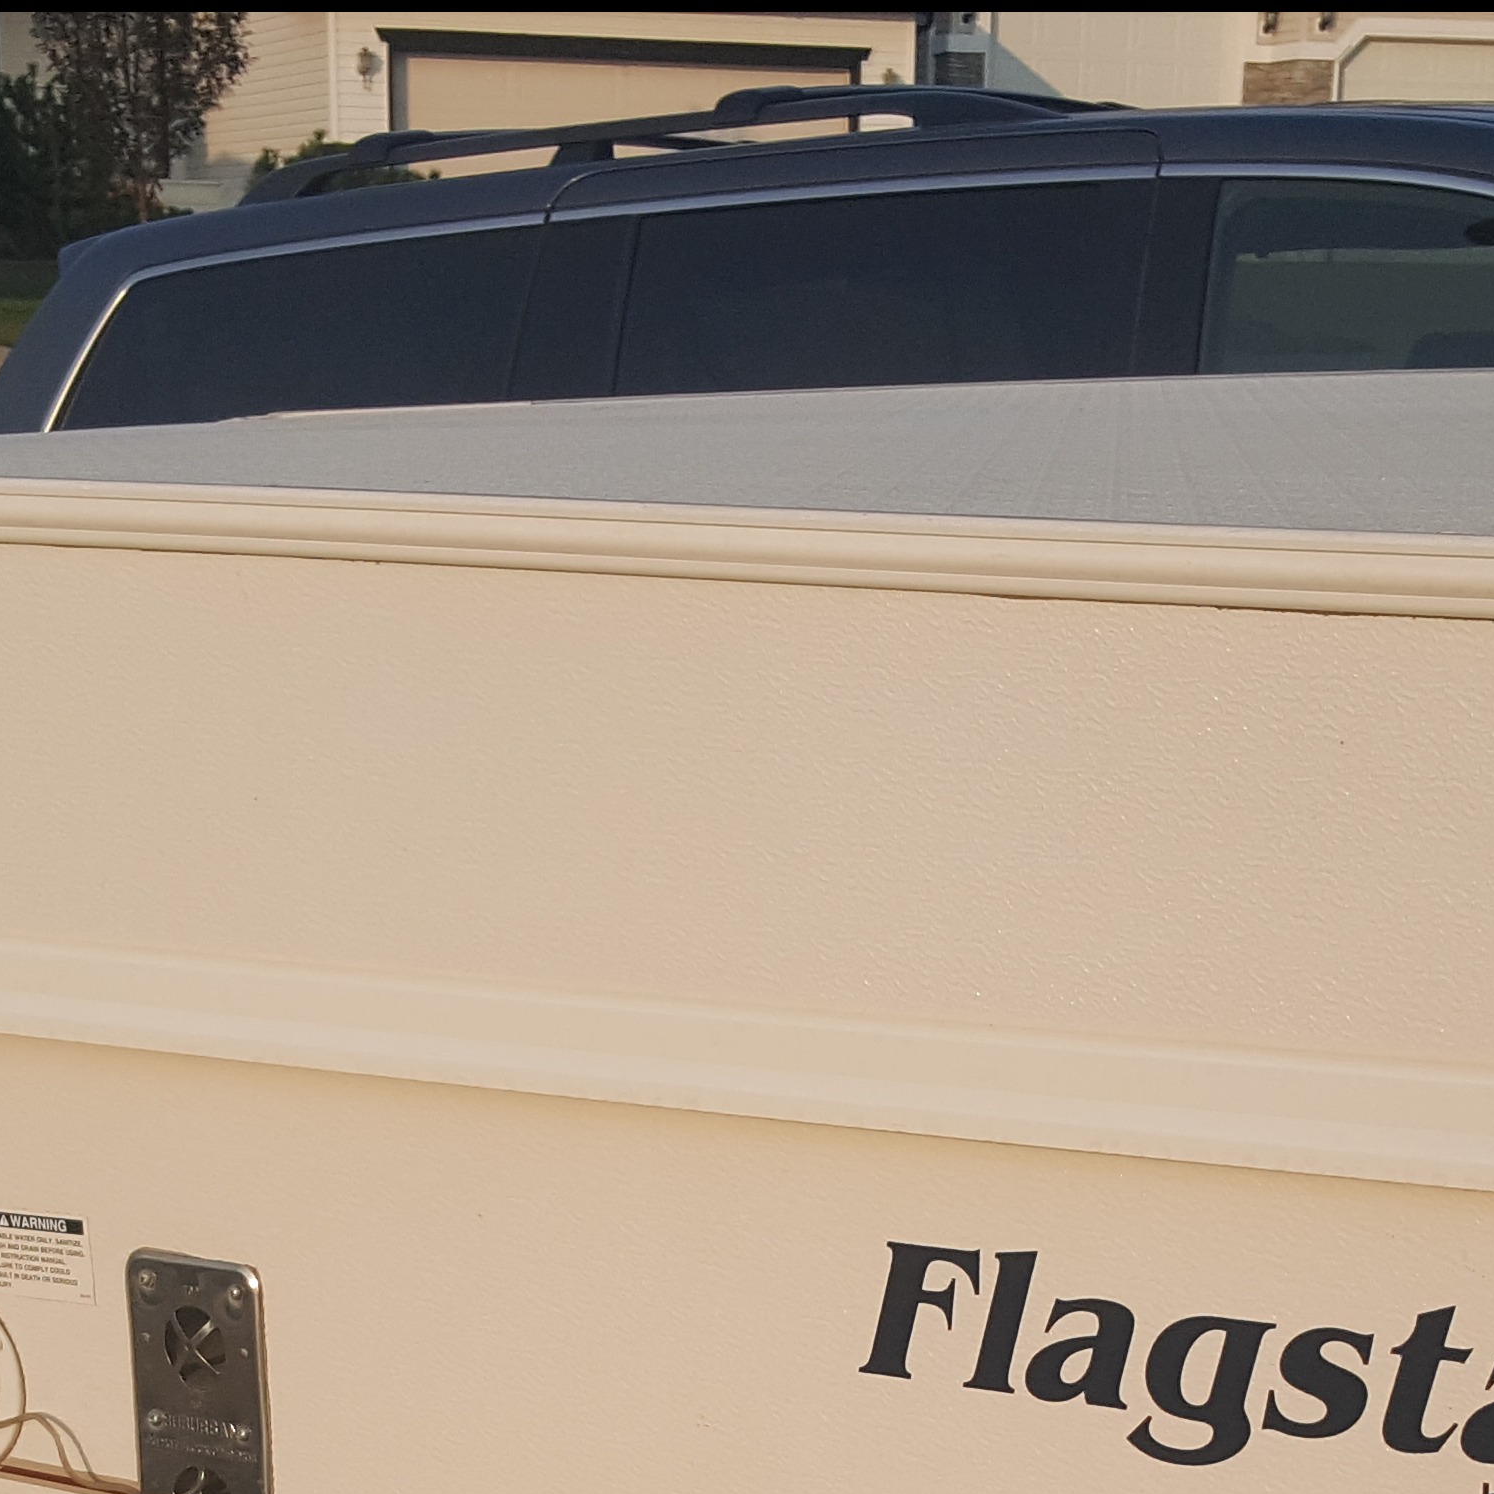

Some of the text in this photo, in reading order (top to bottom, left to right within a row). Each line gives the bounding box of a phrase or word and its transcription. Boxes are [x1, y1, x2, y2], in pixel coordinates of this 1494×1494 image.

[10, 1215, 67, 1232] WARNING
[41, 1247, 63, 1255] BEFORE
[24, 1264, 48, 1272] COMPLY
